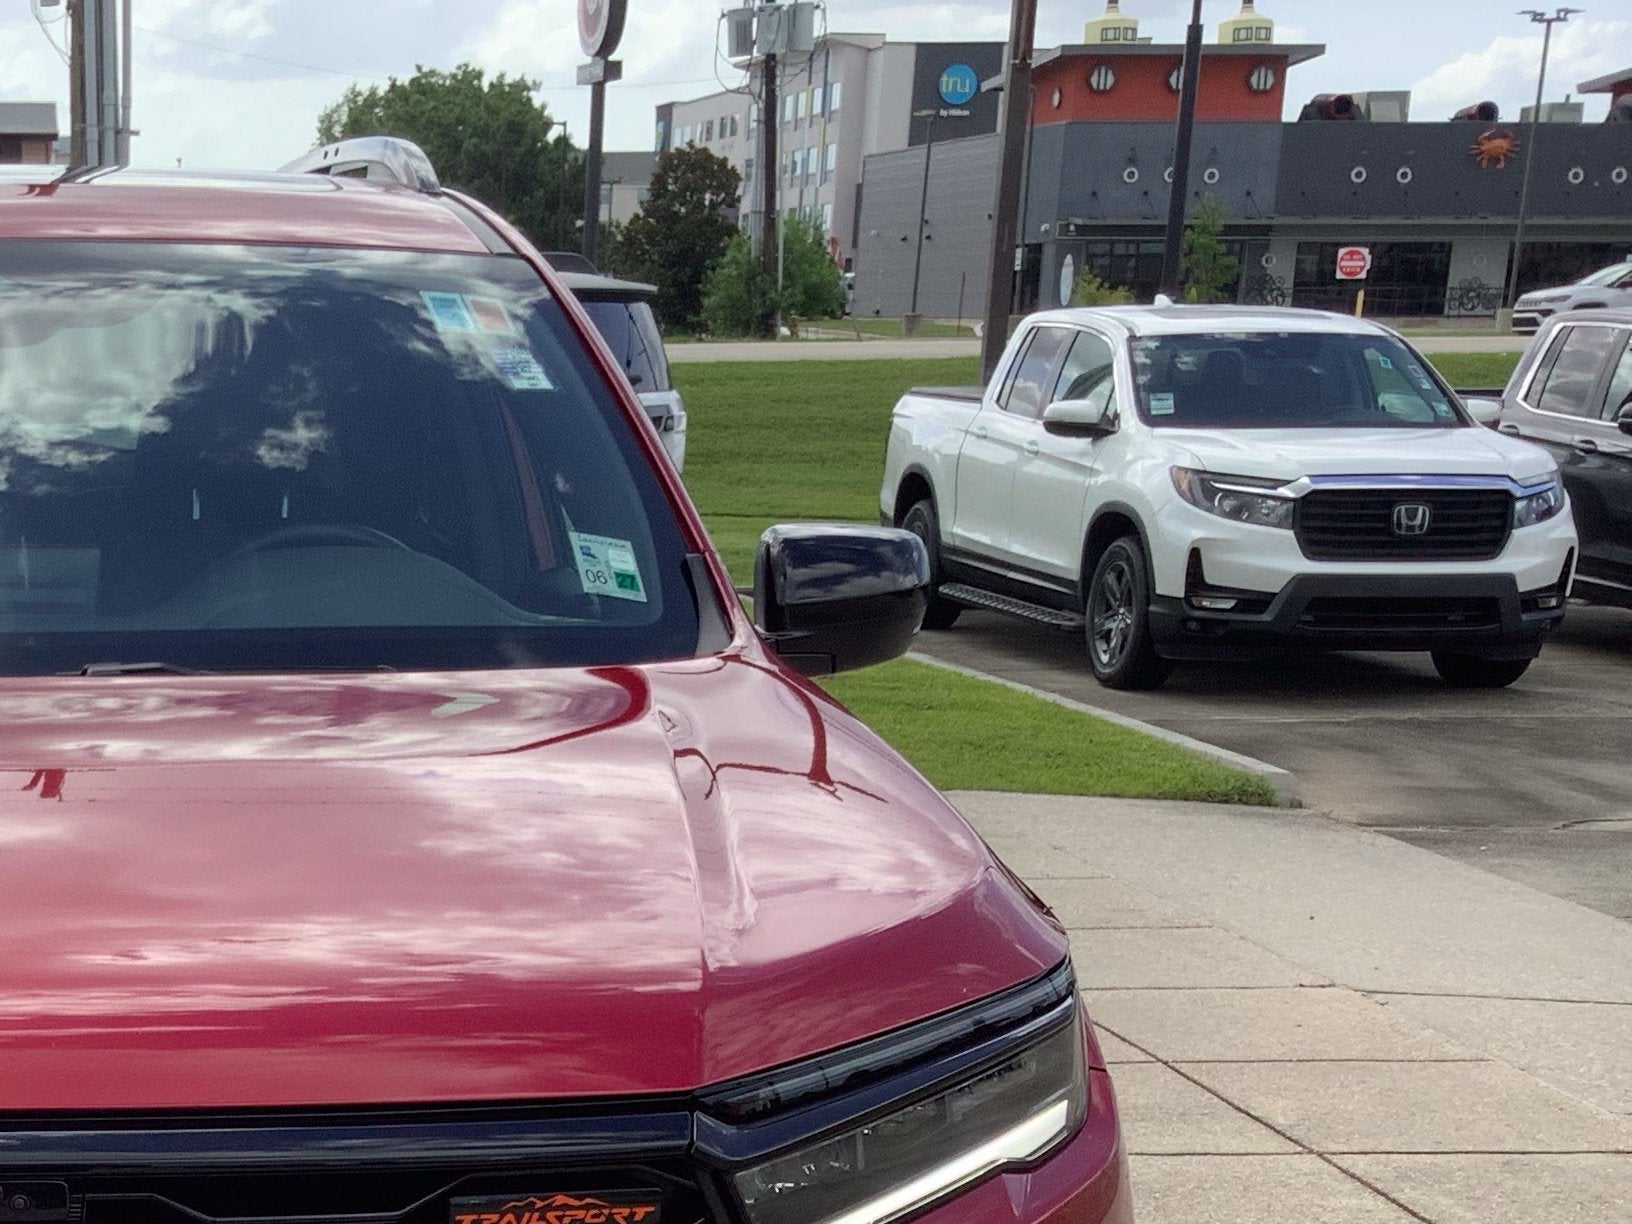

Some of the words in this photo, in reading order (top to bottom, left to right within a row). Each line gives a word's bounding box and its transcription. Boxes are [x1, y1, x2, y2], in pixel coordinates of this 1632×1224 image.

[941, 74, 969, 92] tru
[585, 568, 608, 585] 06
[616, 572, 638, 590] 27
